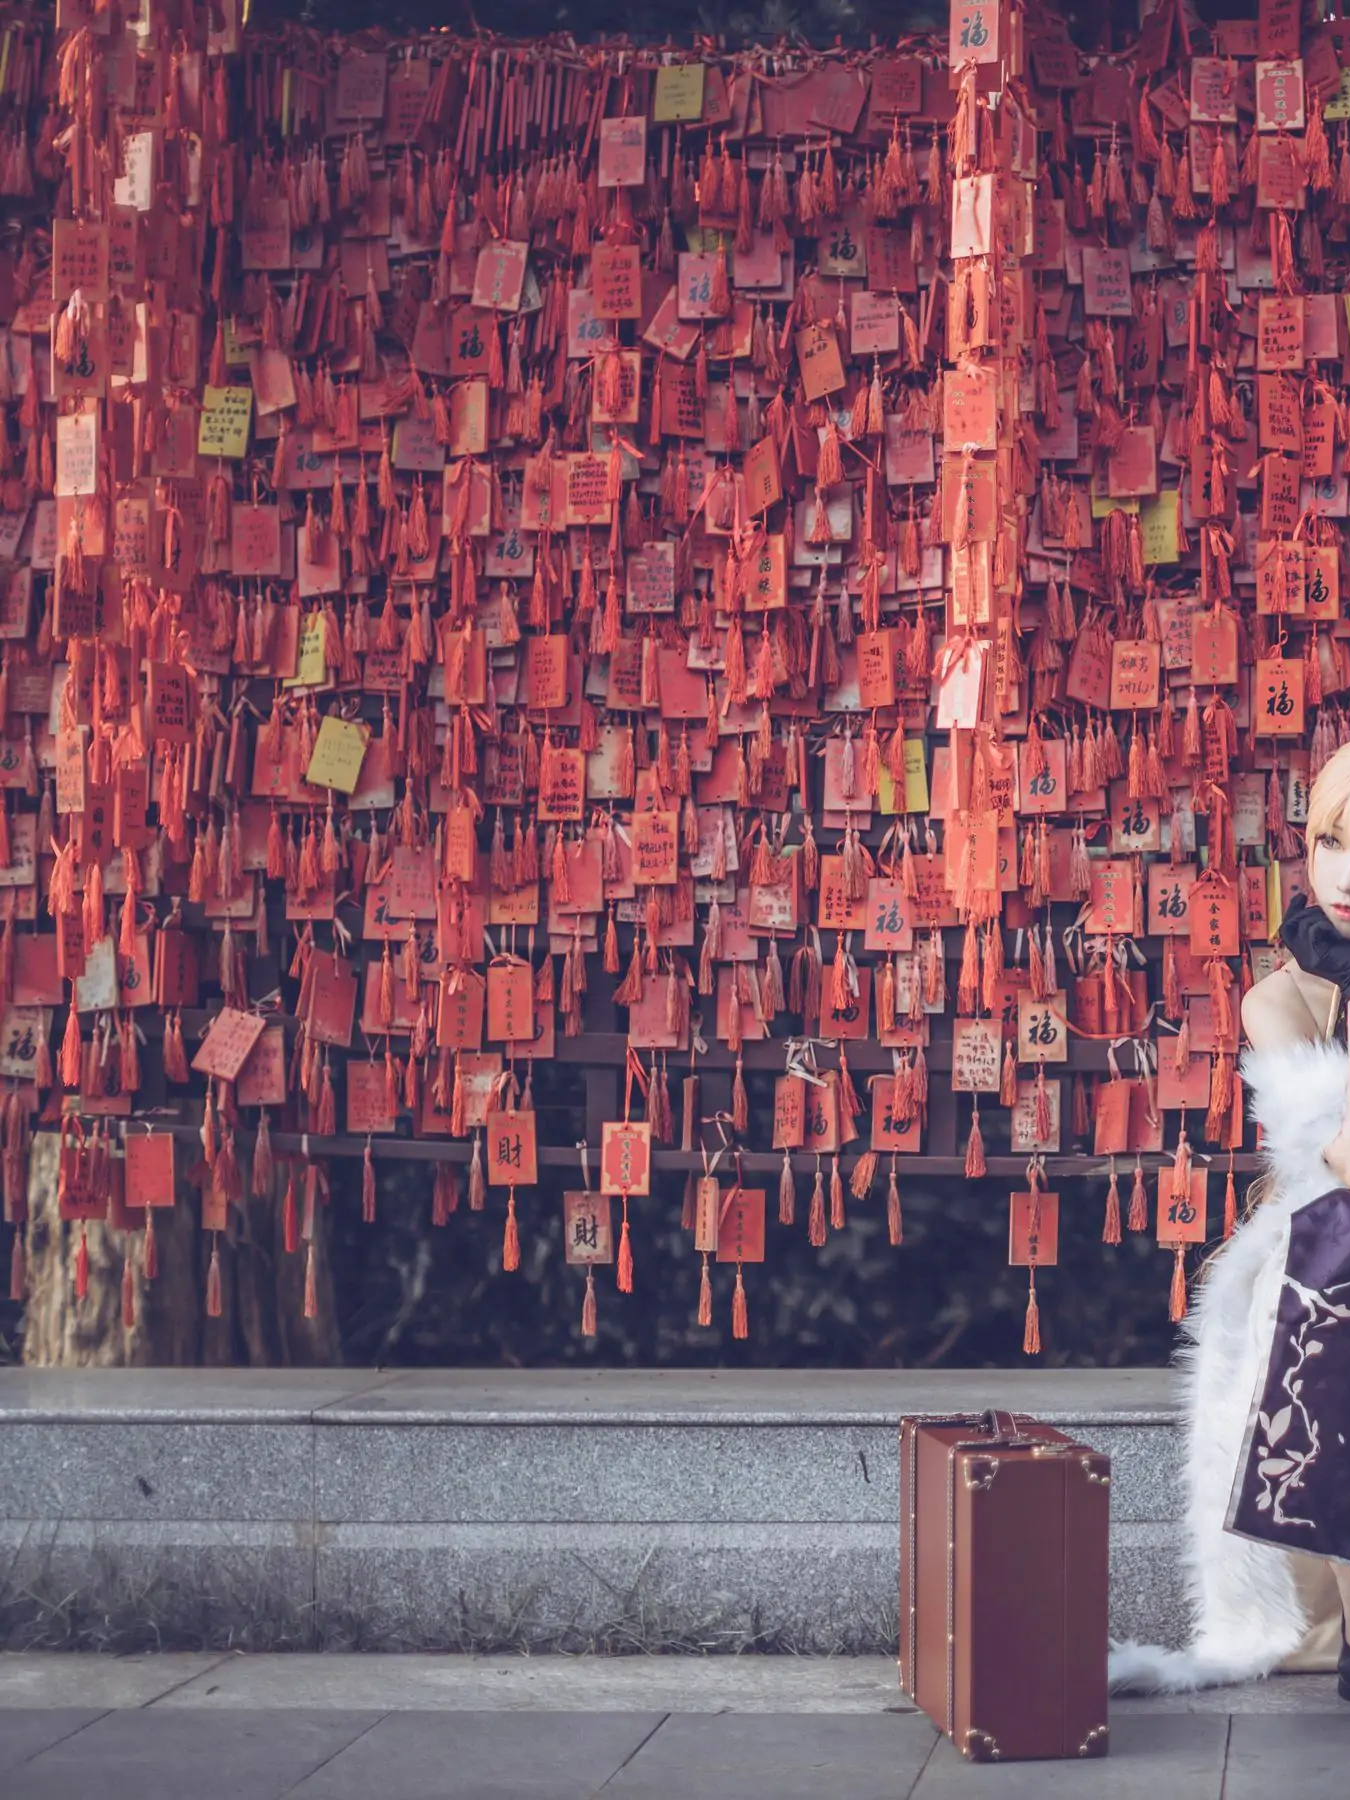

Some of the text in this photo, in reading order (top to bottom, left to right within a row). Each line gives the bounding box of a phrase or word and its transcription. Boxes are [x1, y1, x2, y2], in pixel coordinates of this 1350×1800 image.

[959, 10, 988, 47] 福
[830, 228, 857, 260] 福
[689, 273, 711, 303] 福
[460, 324, 484, 360] 福
[296, 444, 323, 476] 福
[496, 529, 523, 560] 福
[1304, 568, 1329, 603] 福
[1266, 681, 1294, 716] 福
[1030, 762, 1055, 795] 福
[1122, 799, 1151, 835] 福
[876, 900, 903, 933] 福
[1158, 883, 1187, 918] 福
[1209, 902, 1221, 947] 全家福
[8, 1027, 37, 1060] 福
[1028, 1010, 1057, 1045] 福
[496, 1134, 523, 1169] 財
[1168, 1194, 1196, 1224] 福
[573, 1214, 598, 1249] 財
